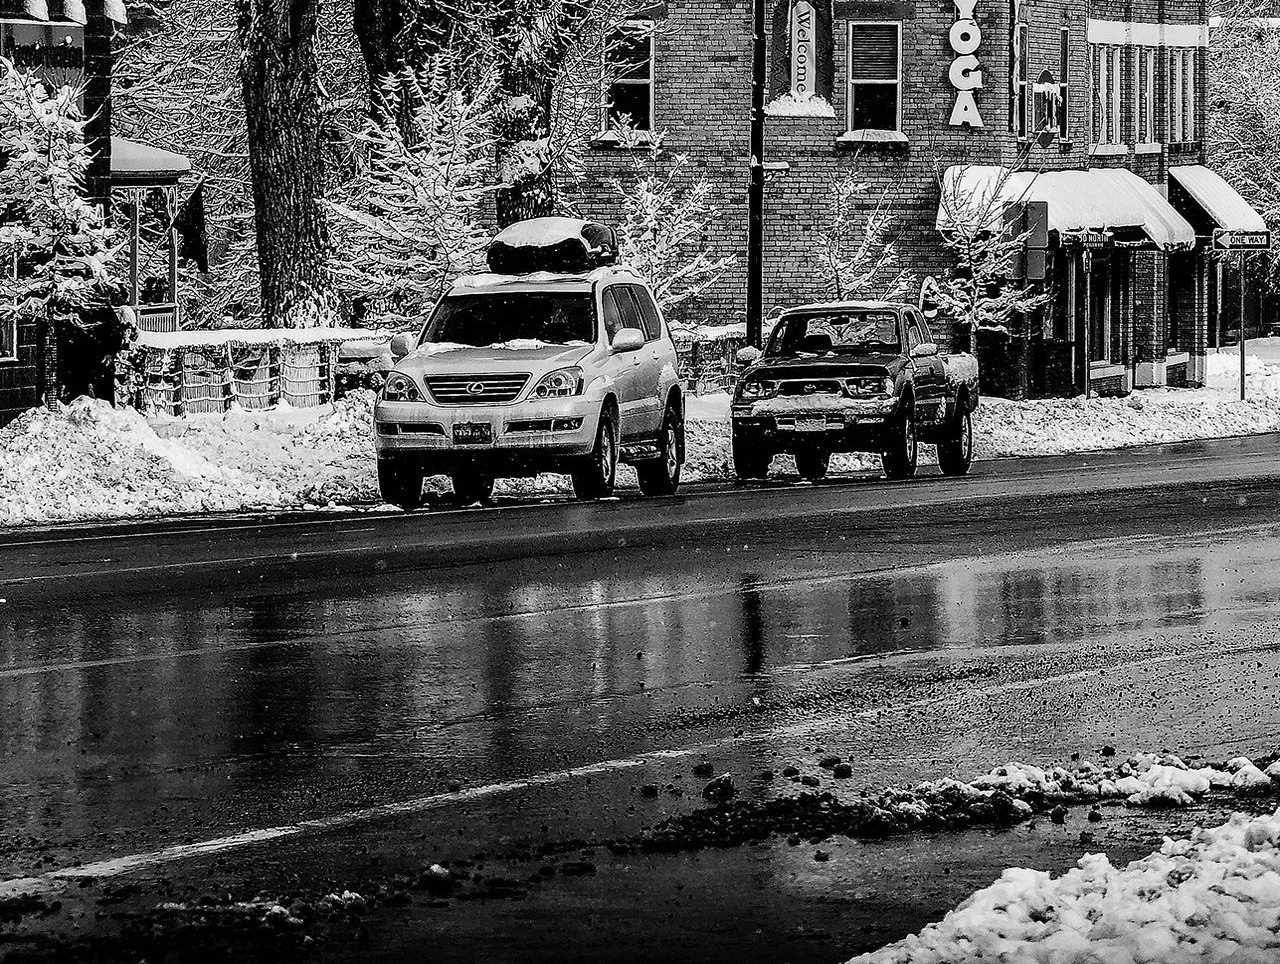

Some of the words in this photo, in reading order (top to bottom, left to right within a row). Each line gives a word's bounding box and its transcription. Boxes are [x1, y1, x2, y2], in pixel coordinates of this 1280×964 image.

[796, 9, 811, 93] Welcome
[1230, 236, 1246, 244] ONE
[1248, 236, 1265, 244] WAY
